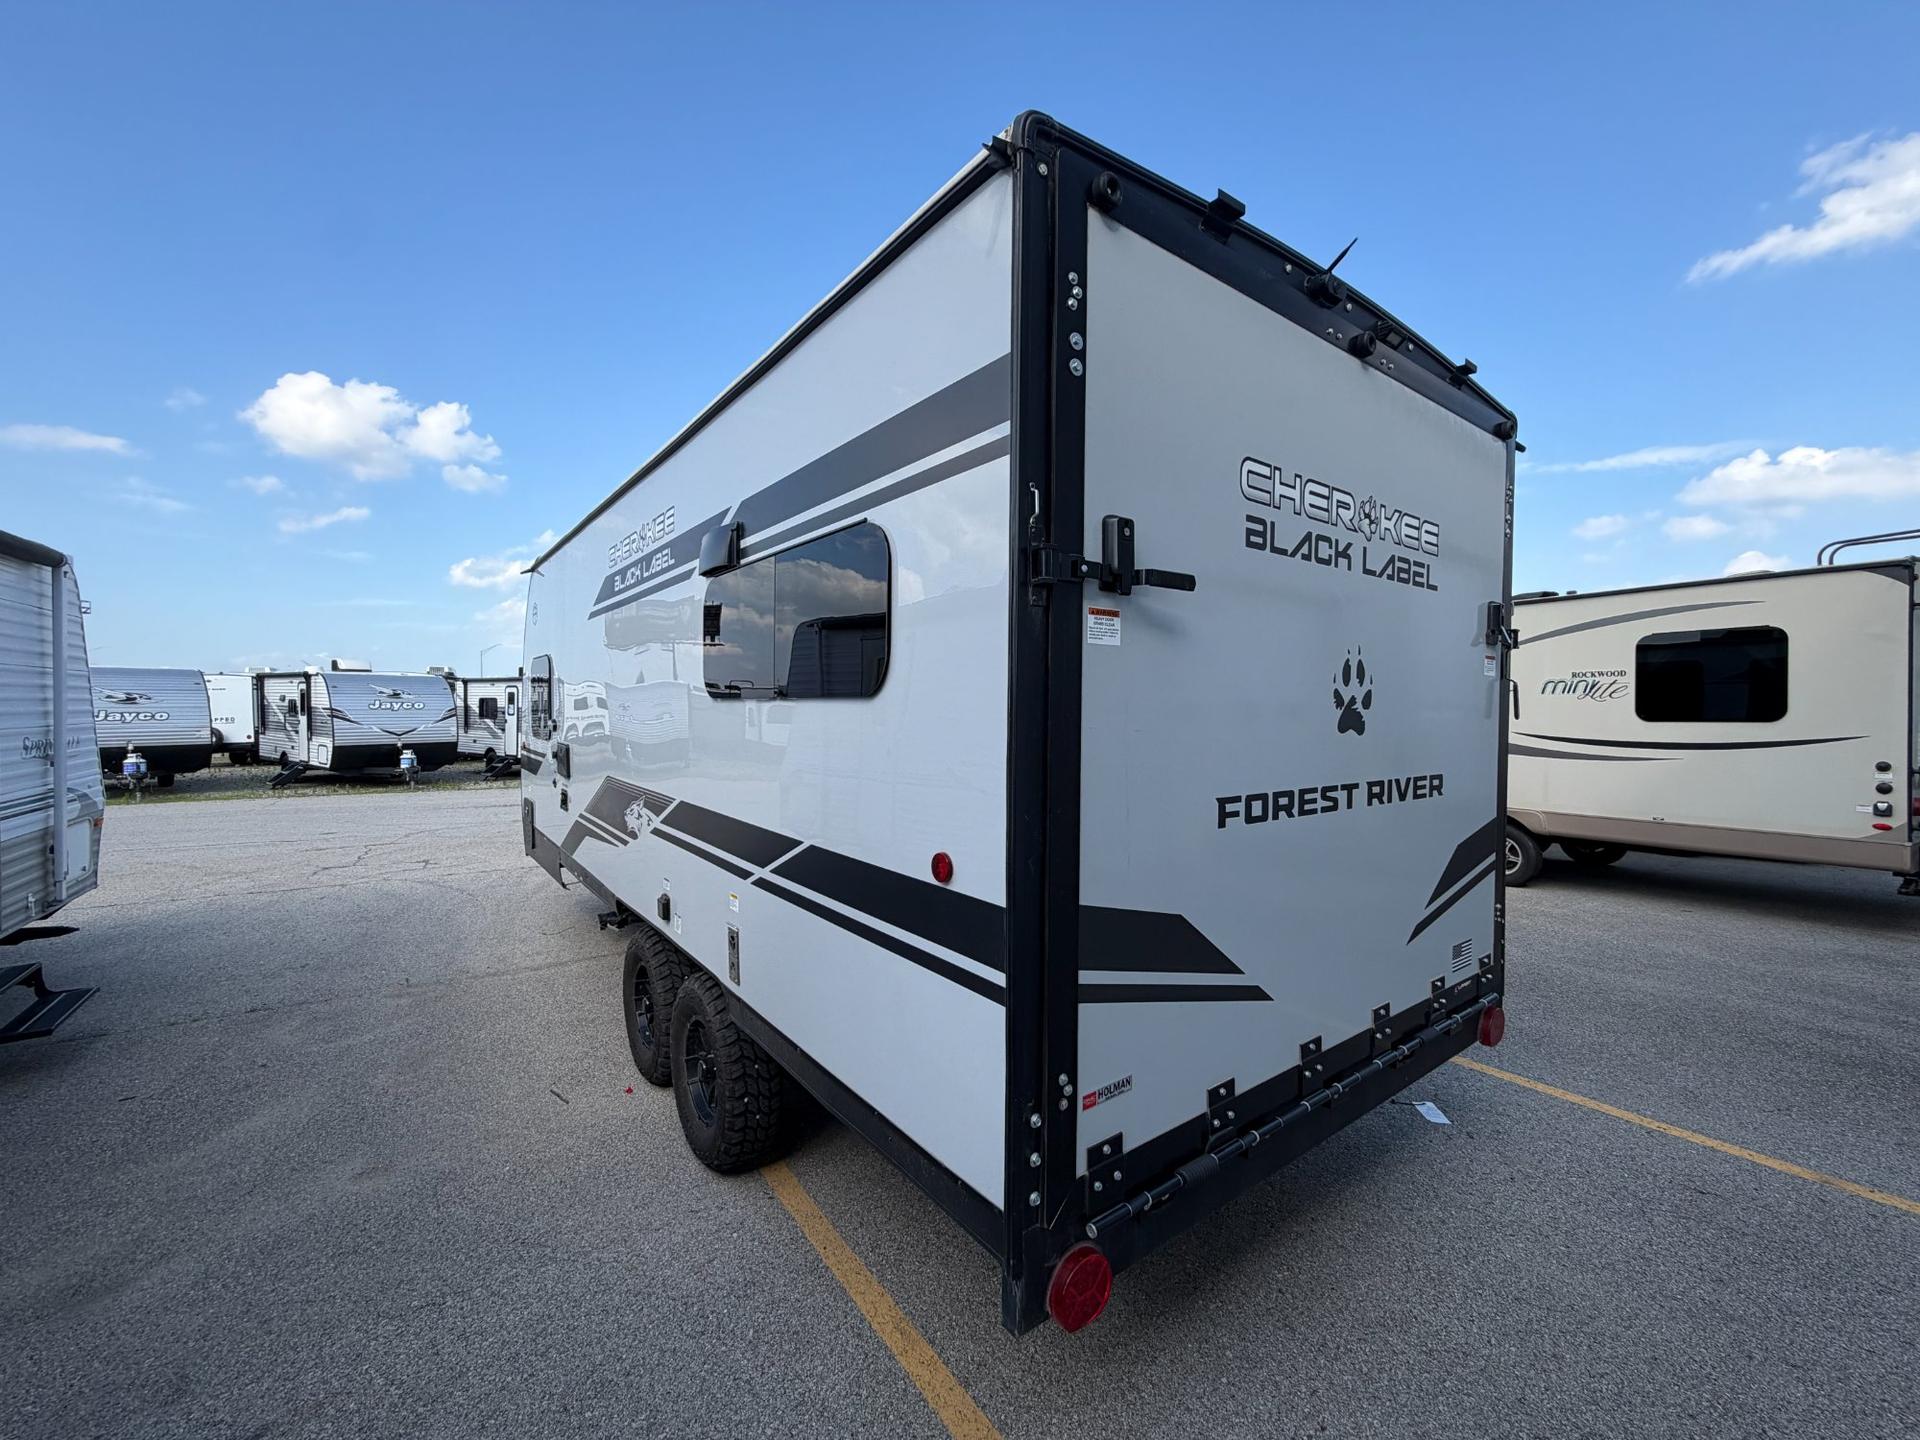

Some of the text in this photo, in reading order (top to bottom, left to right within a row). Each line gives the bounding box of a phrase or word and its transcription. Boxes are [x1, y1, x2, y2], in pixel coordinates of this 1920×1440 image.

[1245, 514, 1438, 592] BLACK LABEL
[614, 547, 675, 592] BLACK LABEL
[1571, 669, 1627, 679] ROCKWOOD
[95, 709, 170, 723] Jayco
[369, 699, 425, 712] Jayco
[1216, 774, 1443, 829] FOREST RIVER
[1097, 1075, 1132, 1100] HOLMAN
